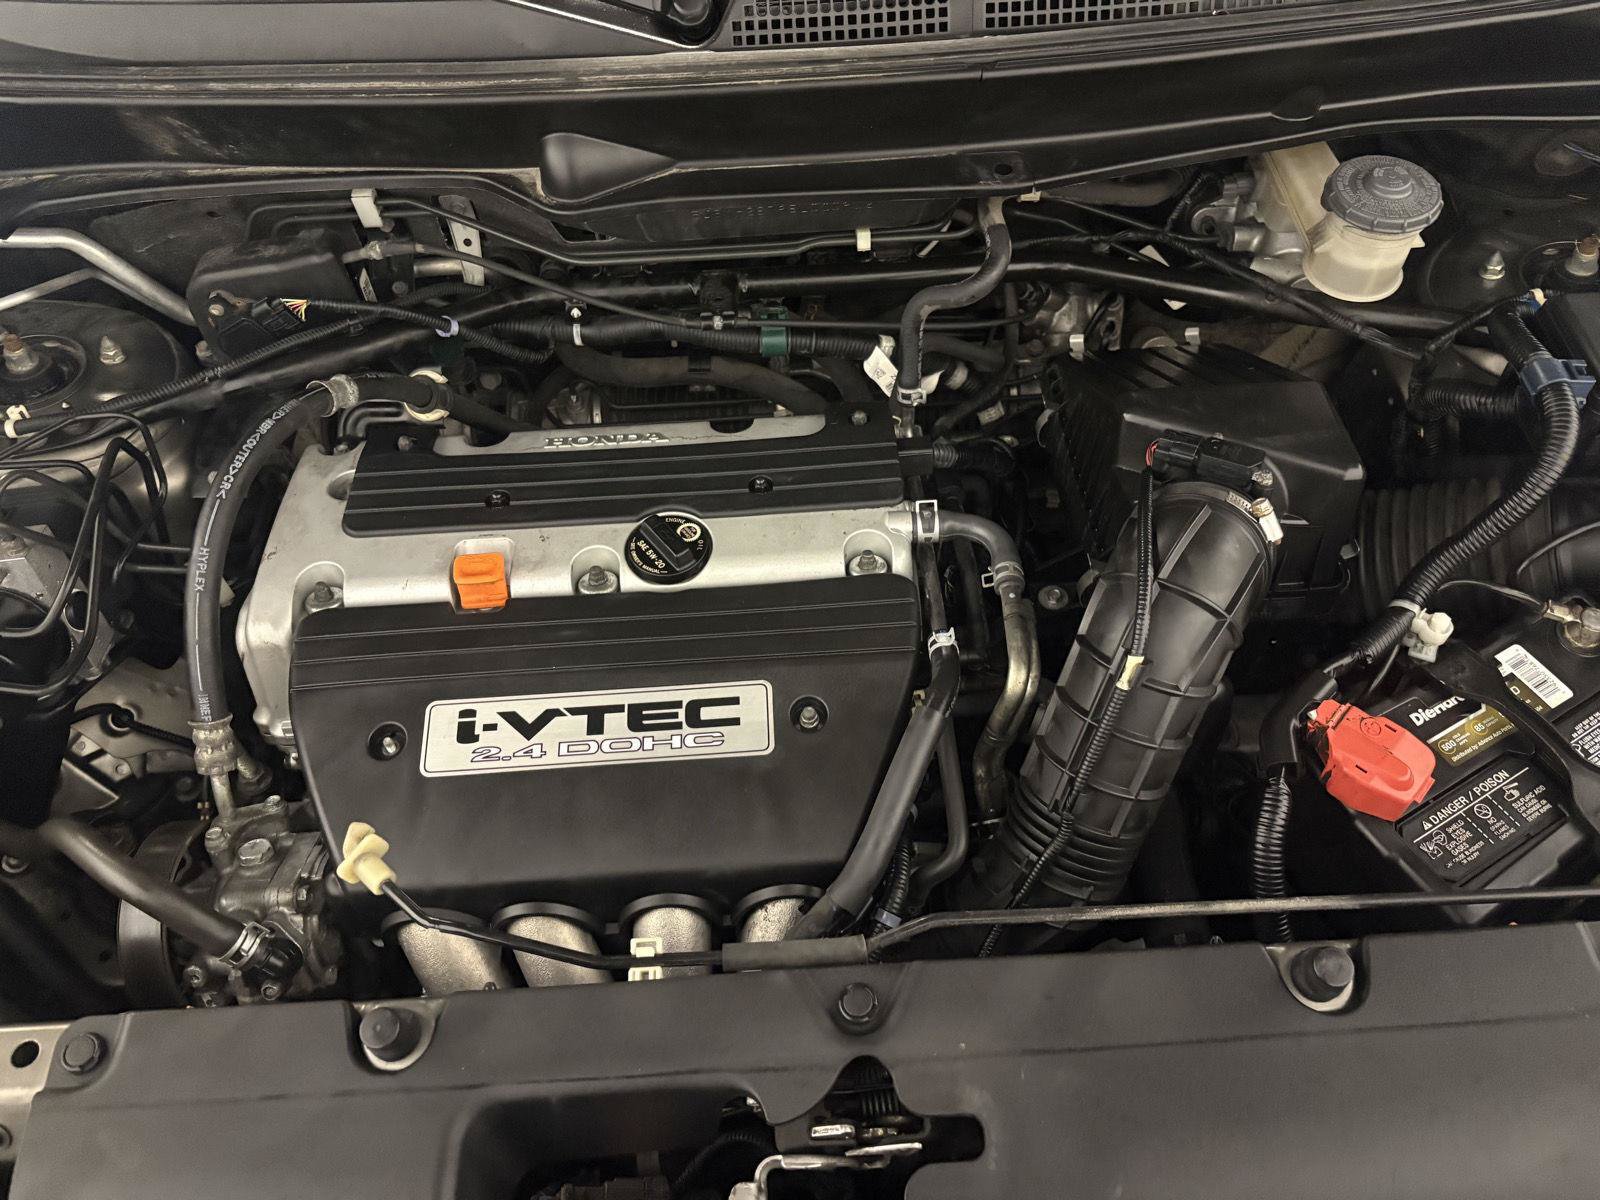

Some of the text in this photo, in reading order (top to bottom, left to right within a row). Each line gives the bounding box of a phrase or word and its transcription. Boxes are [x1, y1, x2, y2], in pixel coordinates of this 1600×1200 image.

[544, 432, 669, 449] HONDA
[637, 540, 649, 551] SAE
[194, 547, 210, 591] HYPLEX
[642, 564, 660, 574] MANUAL
[457, 697, 740, 744] i-VTEC
[1474, 723, 1485, 733] 85
[471, 732, 724, 762] 2.4 DOHC
[1478, 736, 1493, 746] Advance
[1430, 796, 1469, 824] DANGER
[1474, 770, 1510, 796] POISON
[1446, 820, 1464, 833] SHIELD
[1451, 828, 1466, 839] EYES
[1446, 831, 1472, 850] EXPLOSIVE
[1451, 842, 1469, 856] GASES
